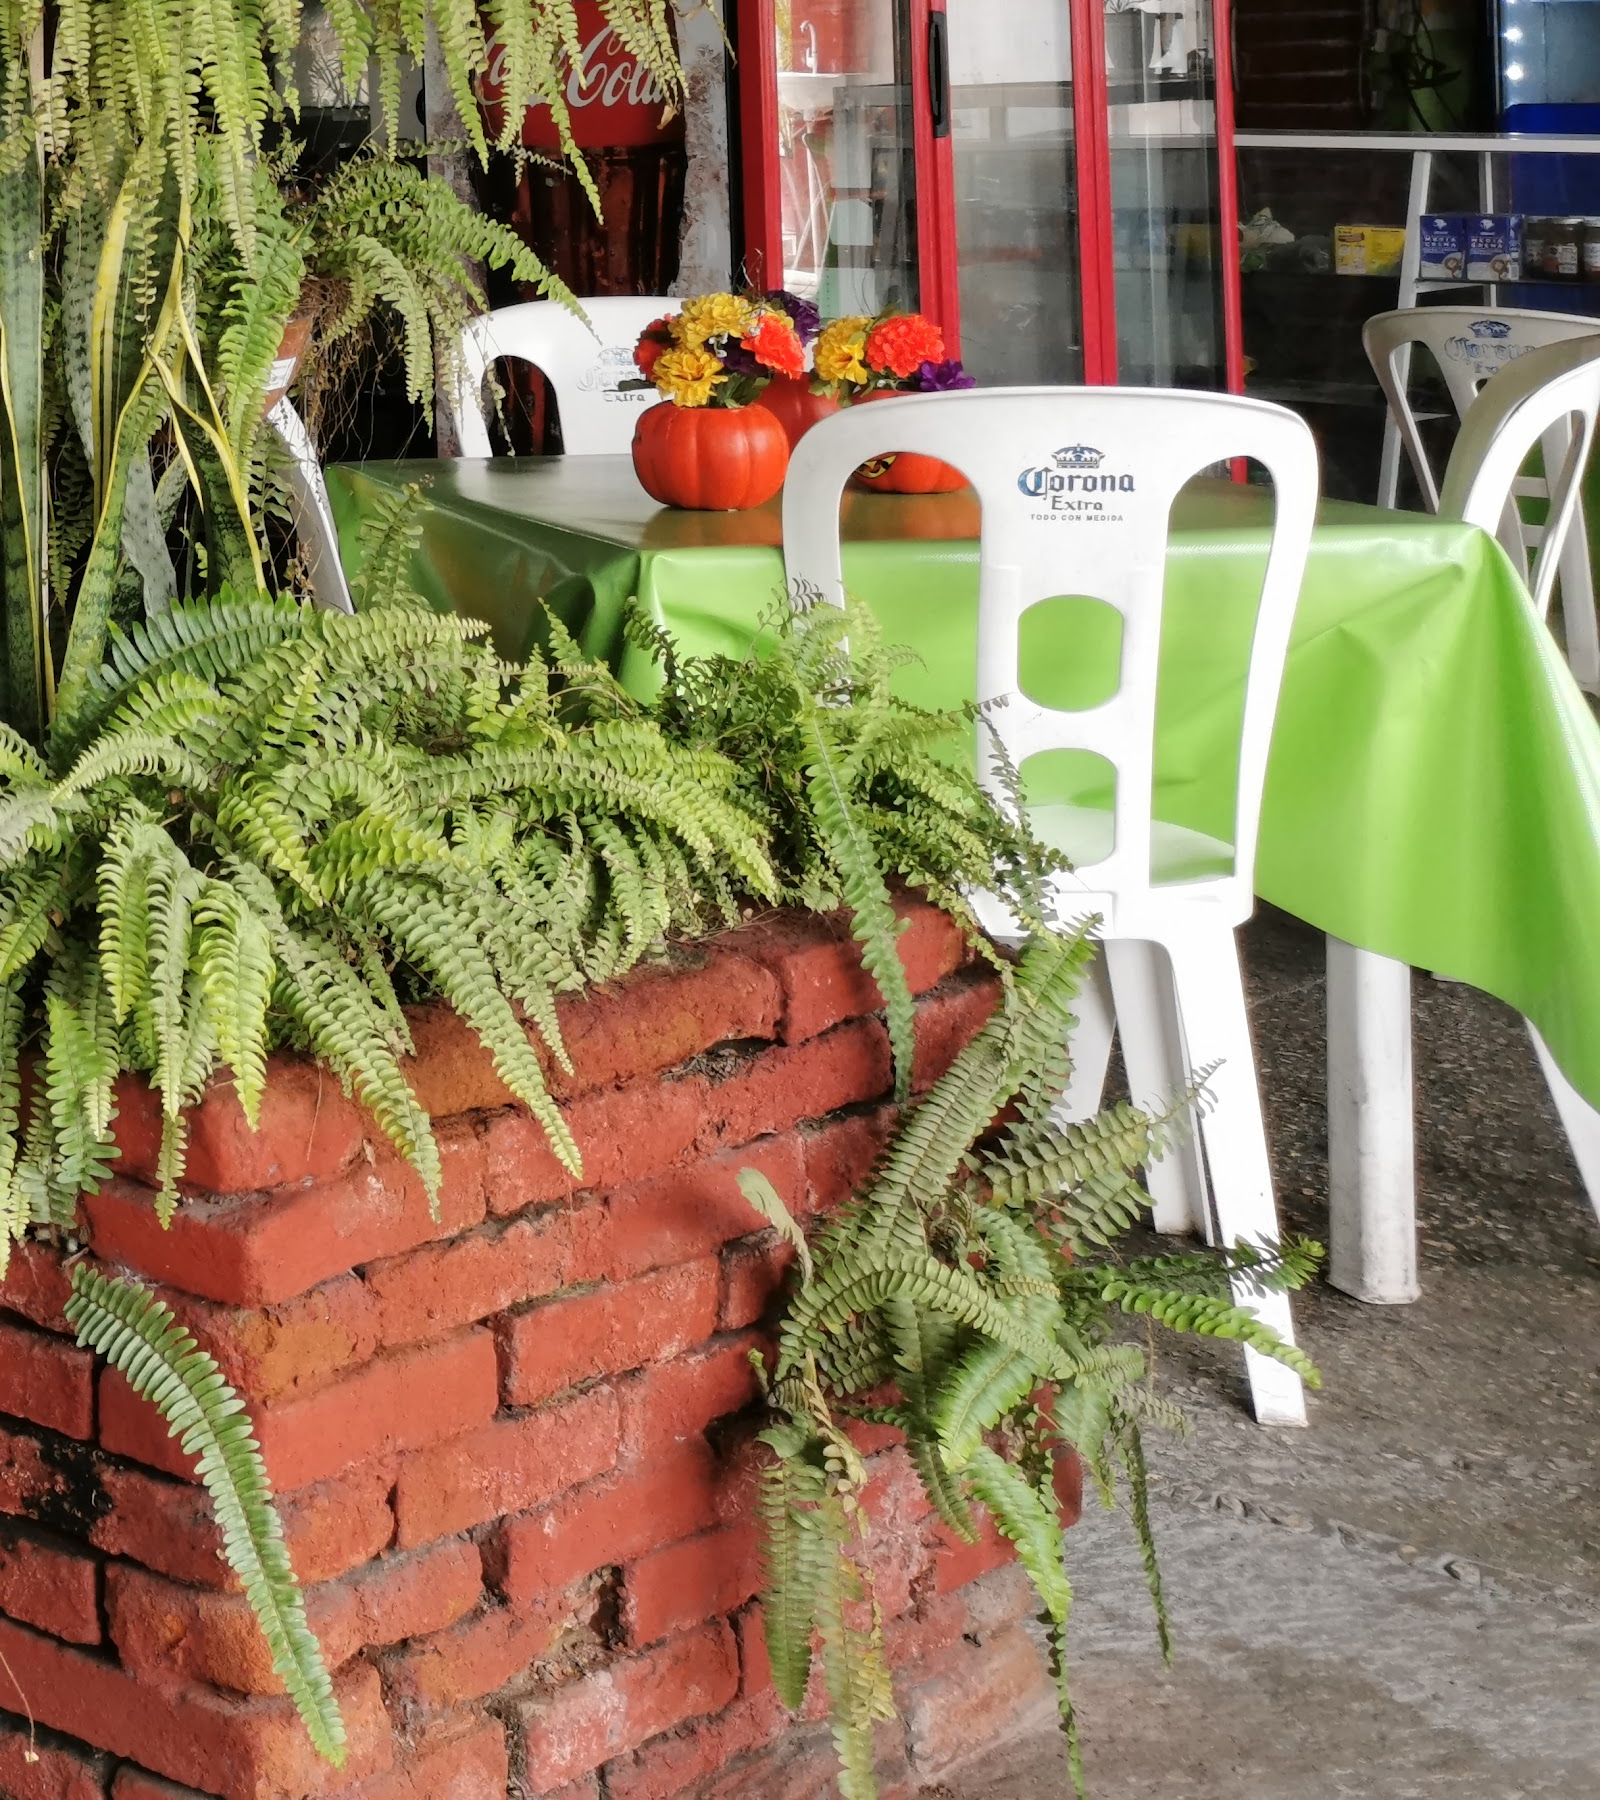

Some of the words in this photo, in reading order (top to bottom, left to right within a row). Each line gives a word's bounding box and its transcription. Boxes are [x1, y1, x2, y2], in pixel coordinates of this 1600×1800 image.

[1017, 466, 1137, 501] Corona
[1051, 495, 1104, 511] Extra
[1031, 513, 1058, 521] TODO
[1061, 513, 1082, 521] CON
[1086, 513, 1125, 522] MEDIDA
